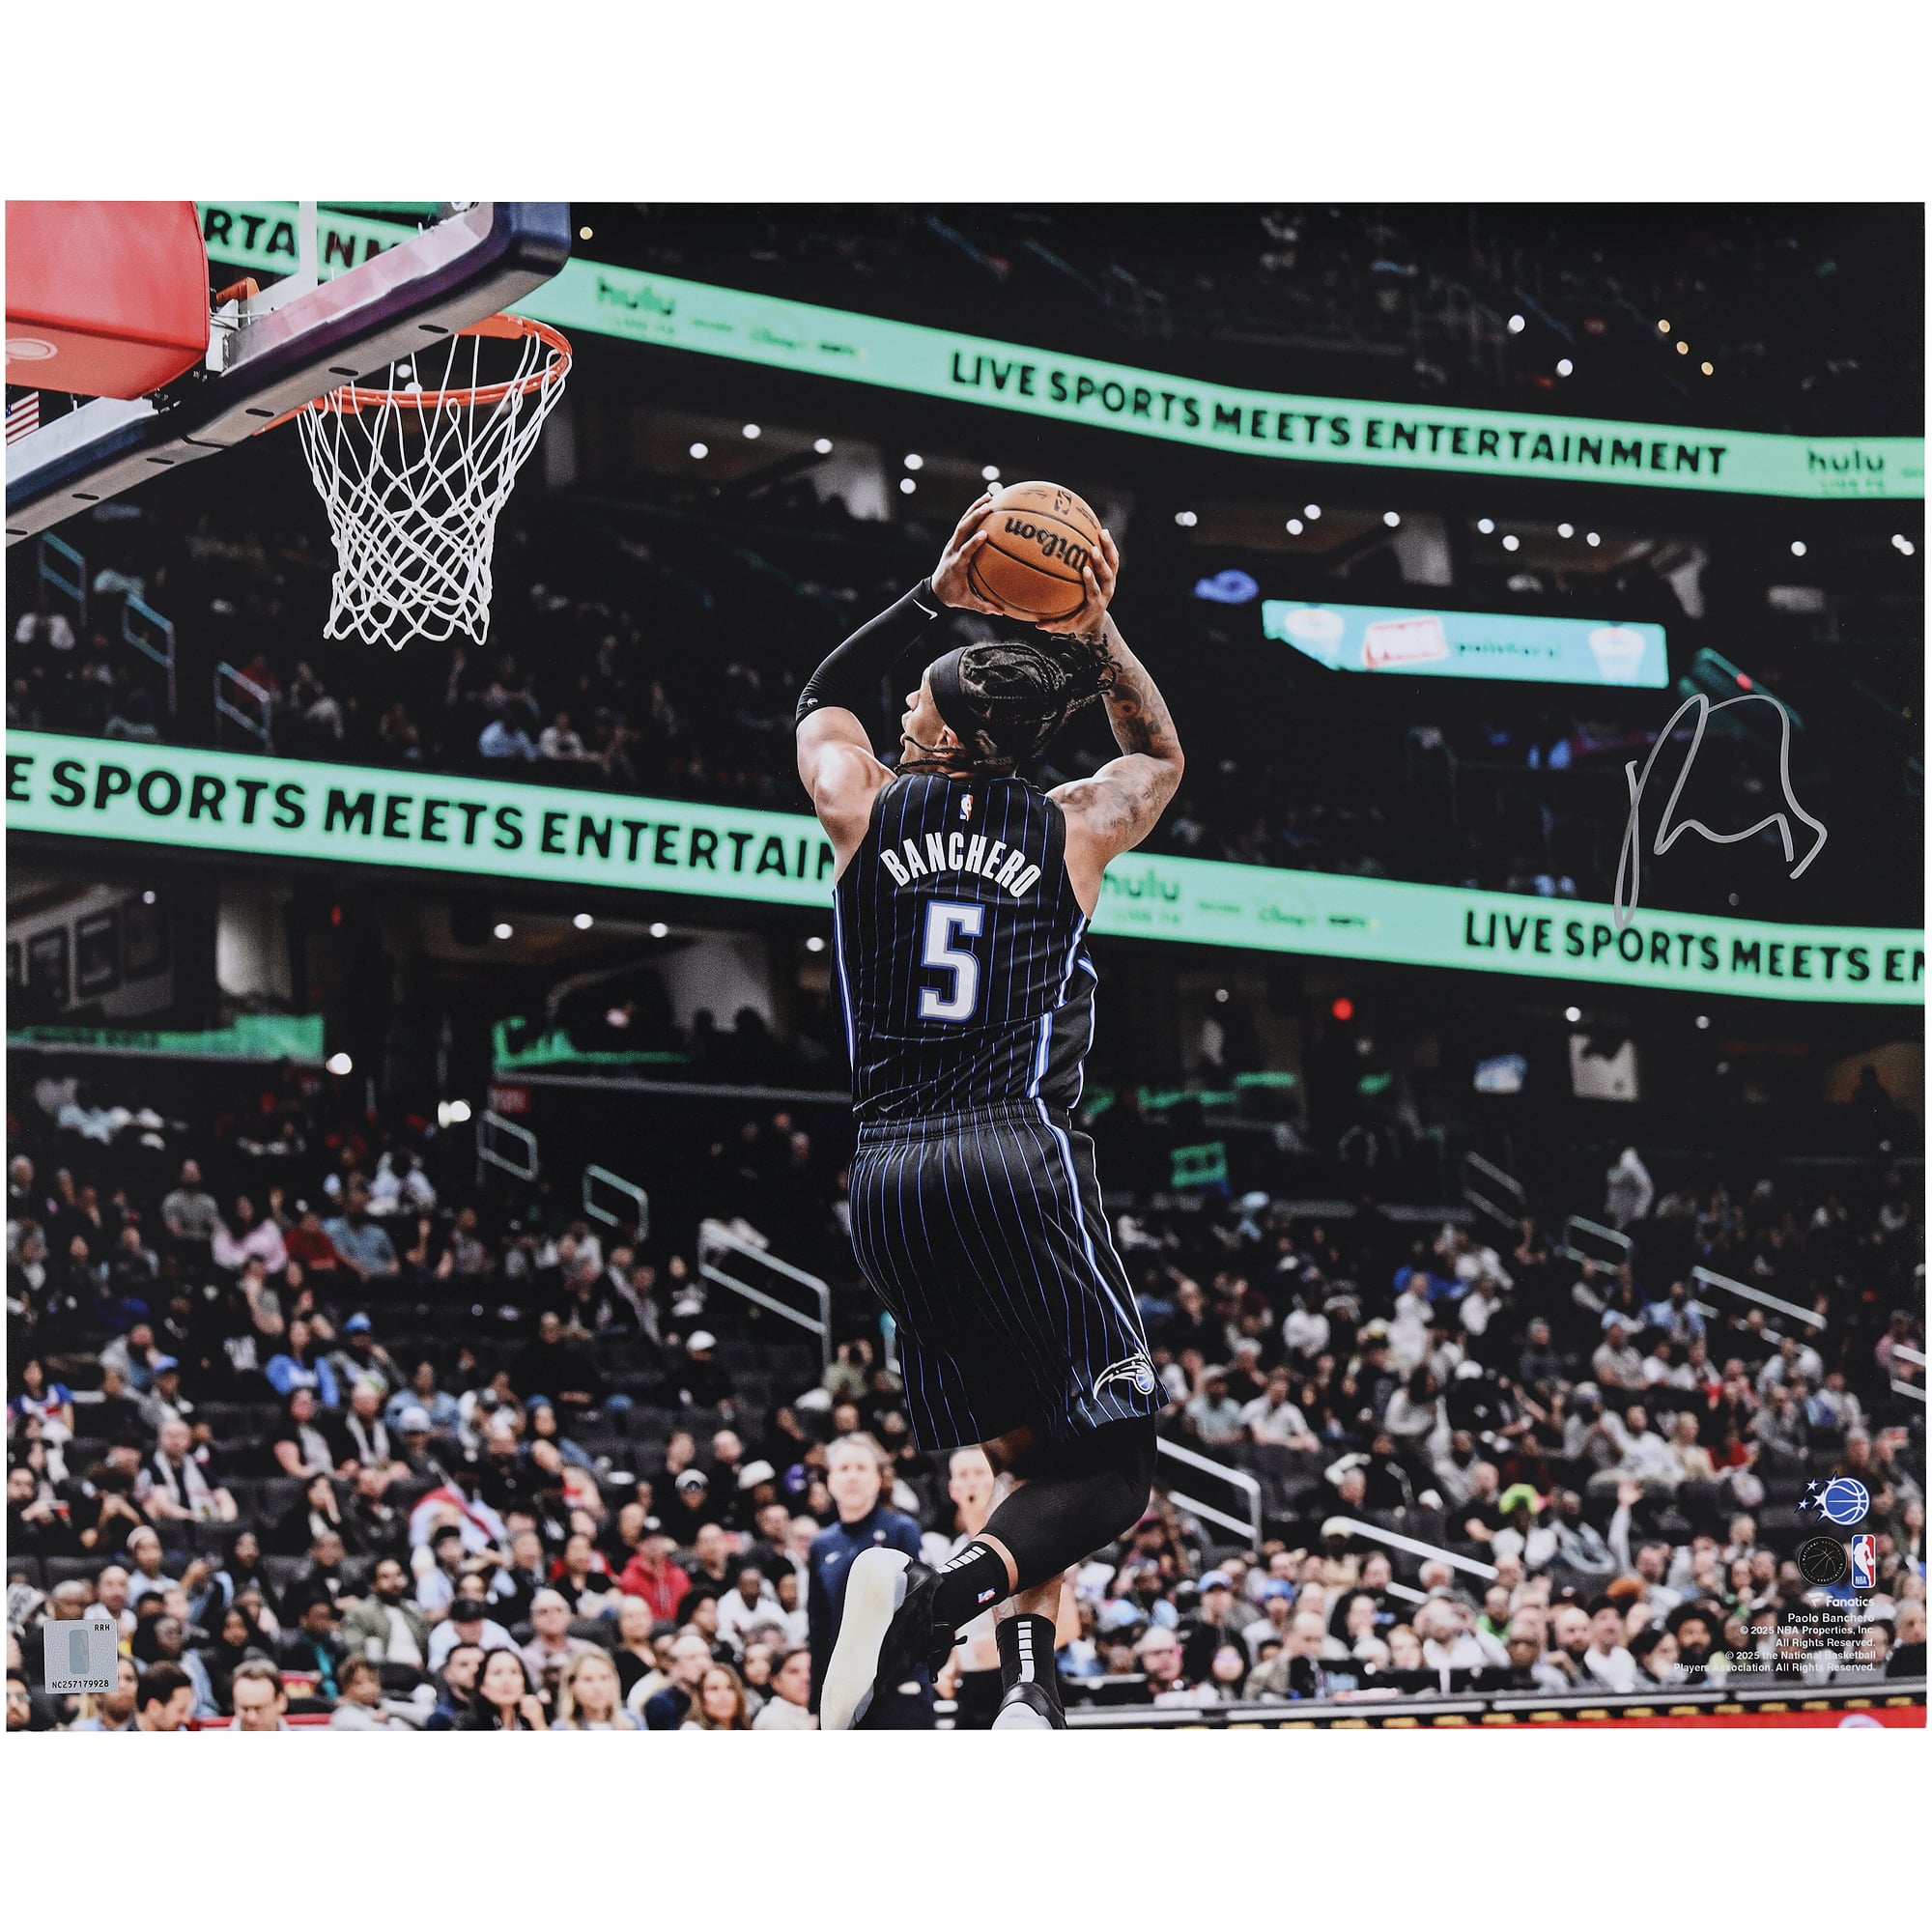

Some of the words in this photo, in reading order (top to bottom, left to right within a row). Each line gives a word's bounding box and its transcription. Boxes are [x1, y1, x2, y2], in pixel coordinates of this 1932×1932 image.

[952, 352, 1036, 397] LIVE
[1050, 370, 1201, 428] SPORTS
[1213, 403, 1350, 446] MEETS
[1365, 419, 1727, 475] ENTERTAINMENT
[1807, 446, 1885, 473] hulu
[1005, 516, 1089, 573] Wilson
[50, 760, 305, 829] SPORTS
[325, 788, 524, 851] MEETS
[880, 832, 1041, 897] BANCHERO
[918, 899, 985, 1023] 5
[1465, 910, 1552, 954] LIVE
[1565, 921, 1719, 972] SPORTS
[1731, 939, 1870, 982] MEETS
[51, 1679, 109, 1689] NC257179928
